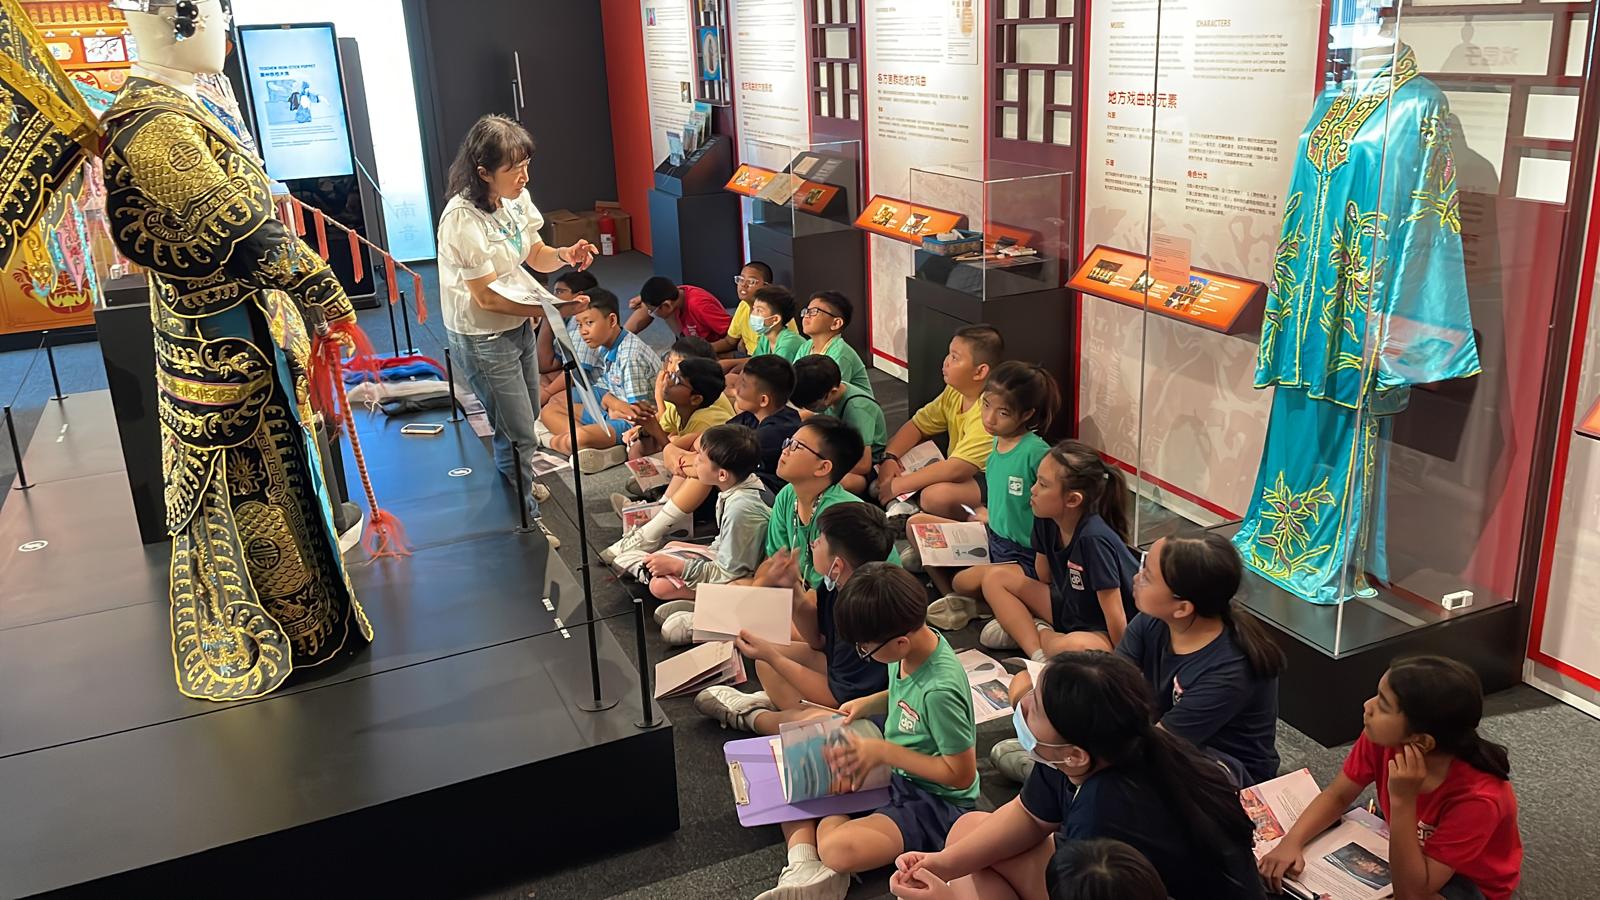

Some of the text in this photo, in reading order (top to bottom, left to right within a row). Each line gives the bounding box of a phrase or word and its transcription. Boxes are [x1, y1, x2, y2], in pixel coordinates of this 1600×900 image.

[1196, 19, 1231, 28] CHARACTERS
[1107, 90, 1178, 109] 地方戏曲的元素
